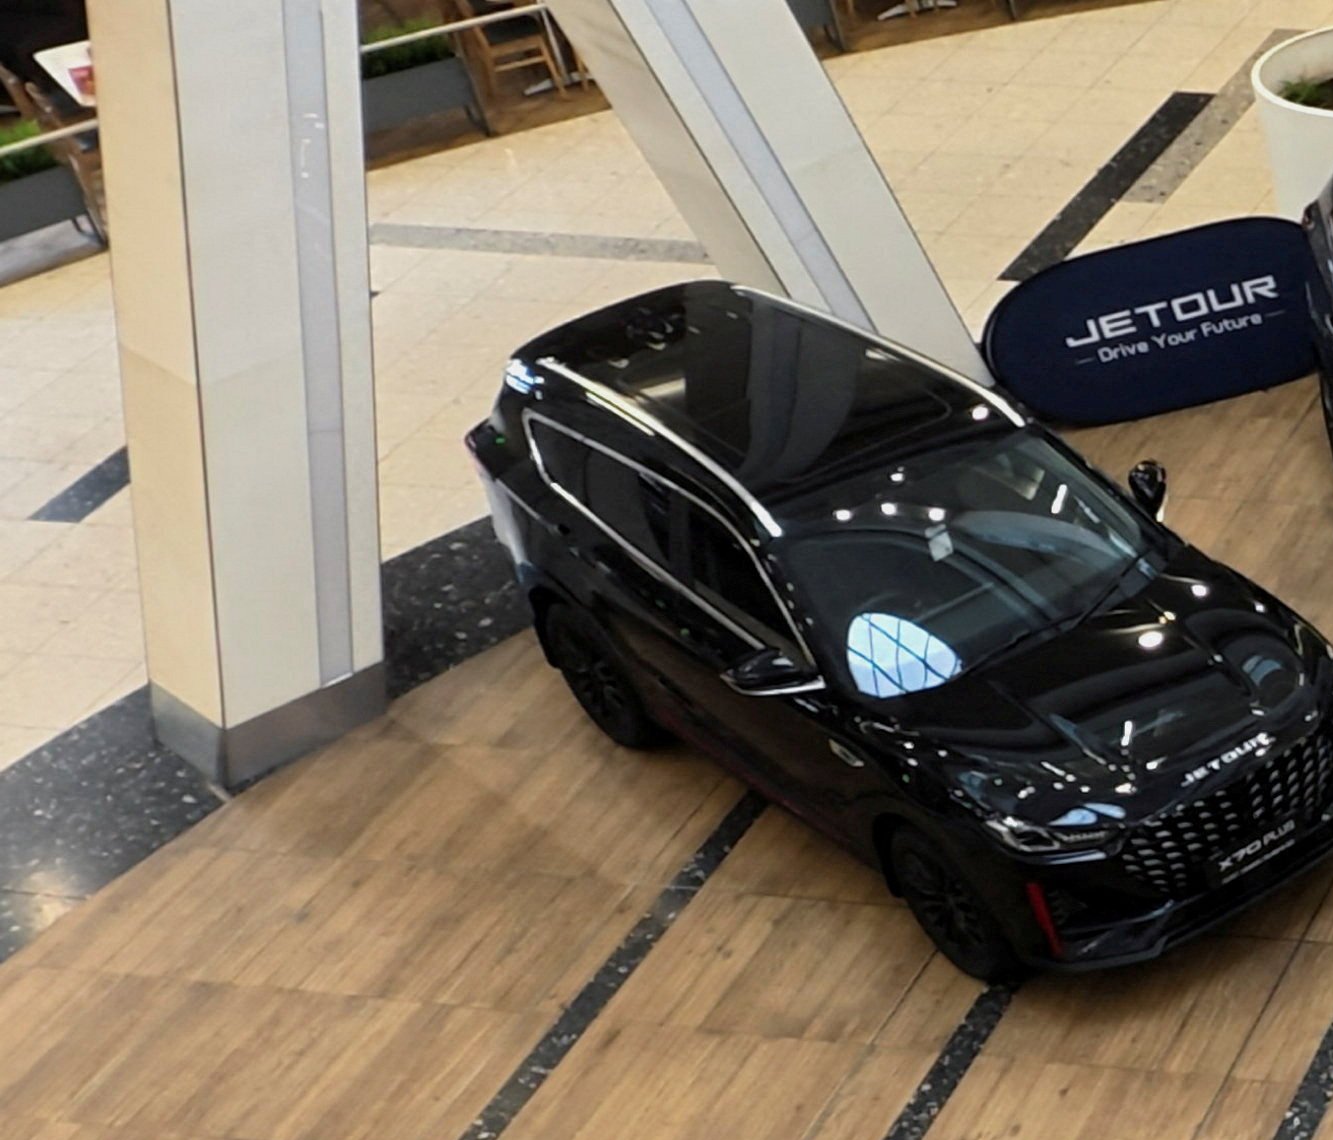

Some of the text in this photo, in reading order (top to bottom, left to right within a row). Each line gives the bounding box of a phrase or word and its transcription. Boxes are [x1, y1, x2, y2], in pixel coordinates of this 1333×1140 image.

[1065, 275, 1279, 347] JETOUR
[1097, 313, 1263, 363] Drive Your Future
[1180, 732, 1276, 787] JETOUR
[1219, 839, 1262, 872] X70
